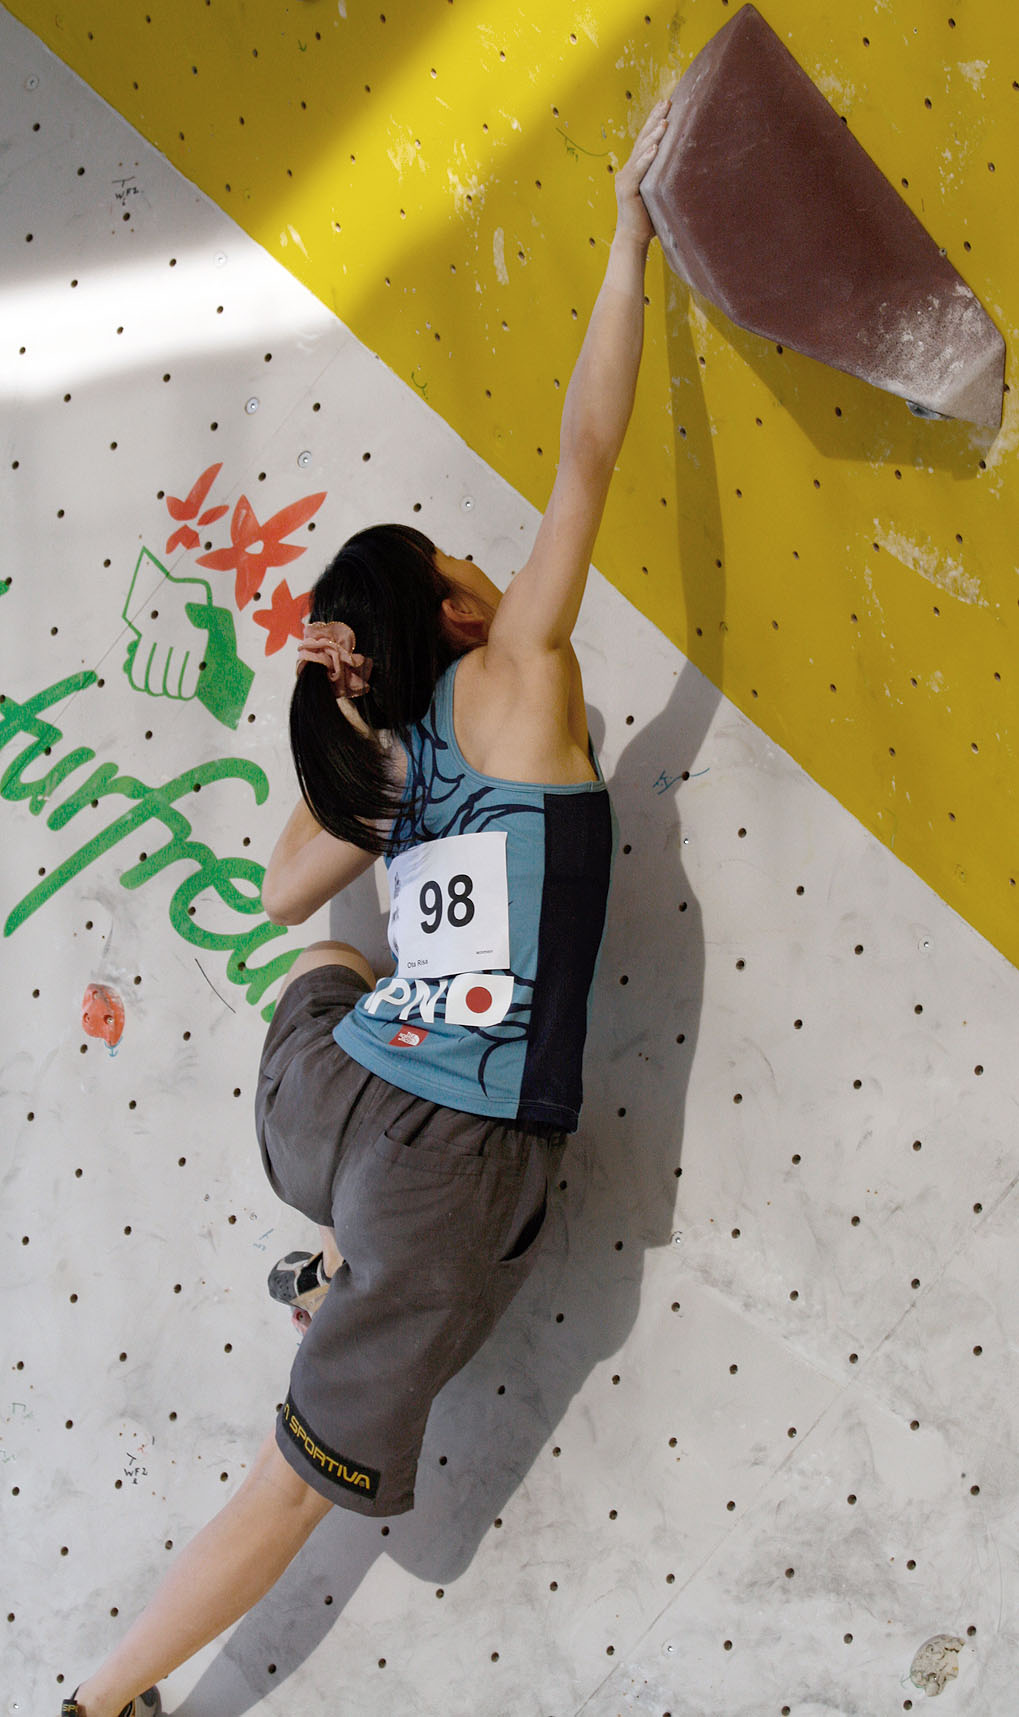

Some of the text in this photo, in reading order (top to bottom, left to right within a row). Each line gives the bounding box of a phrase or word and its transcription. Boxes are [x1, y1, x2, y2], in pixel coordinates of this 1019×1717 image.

[419, 874, 475, 934] 98
[123, 1467, 149, 1477] WF2
[289, 1415, 370, 1489] SPORTIVA
